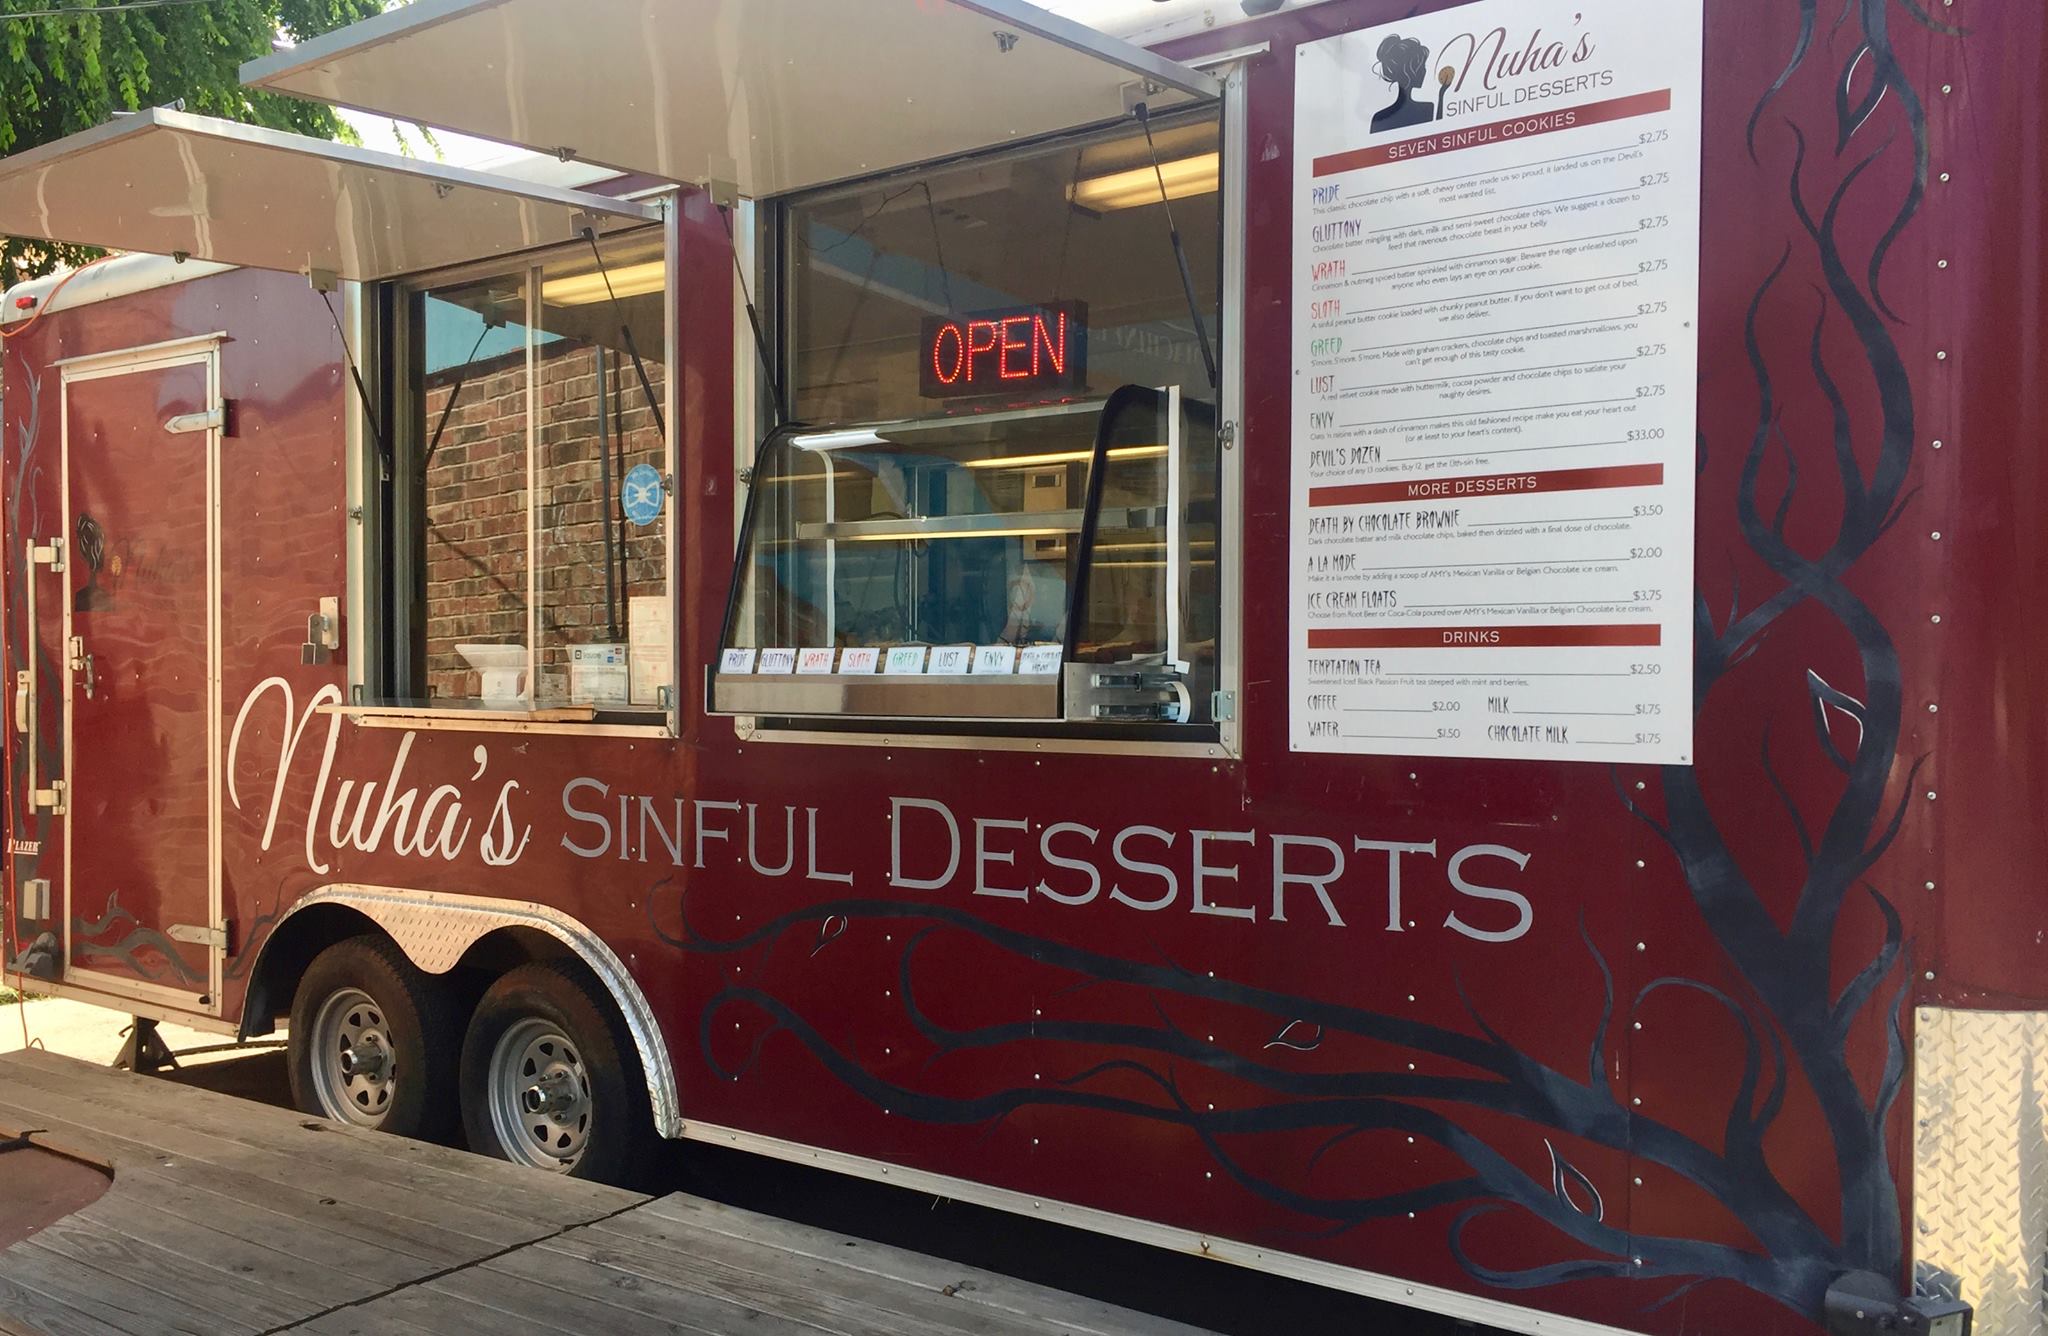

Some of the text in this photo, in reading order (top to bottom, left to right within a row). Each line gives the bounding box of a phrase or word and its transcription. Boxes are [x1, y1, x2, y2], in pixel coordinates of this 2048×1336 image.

[1434, 12, 1597, 94] Nuha's
[1446, 70, 1613, 117] SINFUL DESSERTS
[1388, 112, 1576, 159] SEVEN SINFUL COOKIES
[1312, 129, 1669, 205] PRIDE $2.75
[1312, 172, 1670, 243] GLUTTONY $2.75
[1388, 242, 1402, 251] feed
[1418, 236, 1448, 246] ravenous
[1450, 231, 1482, 241] chocolate
[1484, 226, 1502, 236] beast
[1512, 222, 1527, 233] your
[1312, 215, 1669, 282] WRATH $2.75
[1391, 282, 1413, 291] anyone
[1432, 276, 1448, 284] even
[1450, 272, 1462, 283] lays
[1474, 271, 1487, 280] eye
[1500, 267, 1514, 277] your
[1312, 259, 1668, 320] SLOTH $2.75
[1450, 314, 1464, 322] also
[1311, 301, 1668, 357] GREED $2.75
[934, 312, 1065, 384] OPEN
[1405, 358, 1421, 366] can't
[1422, 358, 1432, 366] get
[1434, 354, 1459, 365] enough
[1483, 350, 1499, 358] tasty
[1311, 344, 1666, 394] LUST $2.75
[1439, 391, 1464, 399] naughty
[1310, 385, 1666, 429] ENVY $2.75
[1405, 435, 1415, 443] (or
[1425, 432, 1440, 440] least
[1450, 431, 1465, 440] your
[1468, 428, 1490, 438] heart's
[1310, 428, 1664, 468] DEVIL'S DOZEN $33.00
[1408, 476, 1537, 496] MORE DESSERTS
[1309, 505, 1663, 535] DEATH BY CHOCOLATE BROWNIE $3.50
[1324, 537, 1353, 545] chocolate
[1403, 532, 1434, 540] chocolate
[1496, 528, 1522, 536] drizzled
[1308, 547, 1662, 572] A LA MODE $2.00
[1363, 573, 1370, 582] by
[1372, 572, 1392, 580] adding
[1517, 567, 1541, 576] Belgian
[1543, 566, 1580, 574] Chocolate
[1308, 590, 1662, 610] ICE CREAM FLOATS $3.75
[1443, 631, 1500, 643] DRINKS
[727, 651, 747, 667] PRIDE
[761, 651, 794, 667] GLUTTONY
[803, 651, 829, 667] WRATH
[848, 651, 871, 667] SLOTH
[892, 651, 919, 666] GREED
[938, 651, 960, 667] LUST
[984, 651, 1004, 666] ENVY
[1308, 659, 1661, 676] TEMPTATION TEA $2.50
[1308, 695, 1460, 712] COFFEE $2.00
[1488, 696, 1661, 714] MILK $1.75
[1308, 721, 1460, 738] WATER $1.50
[1488, 725, 1661, 744] CHOCOLATE MILK $1.75
[226, 676, 1534, 943] Nuha's SINFUL DESSERTS
